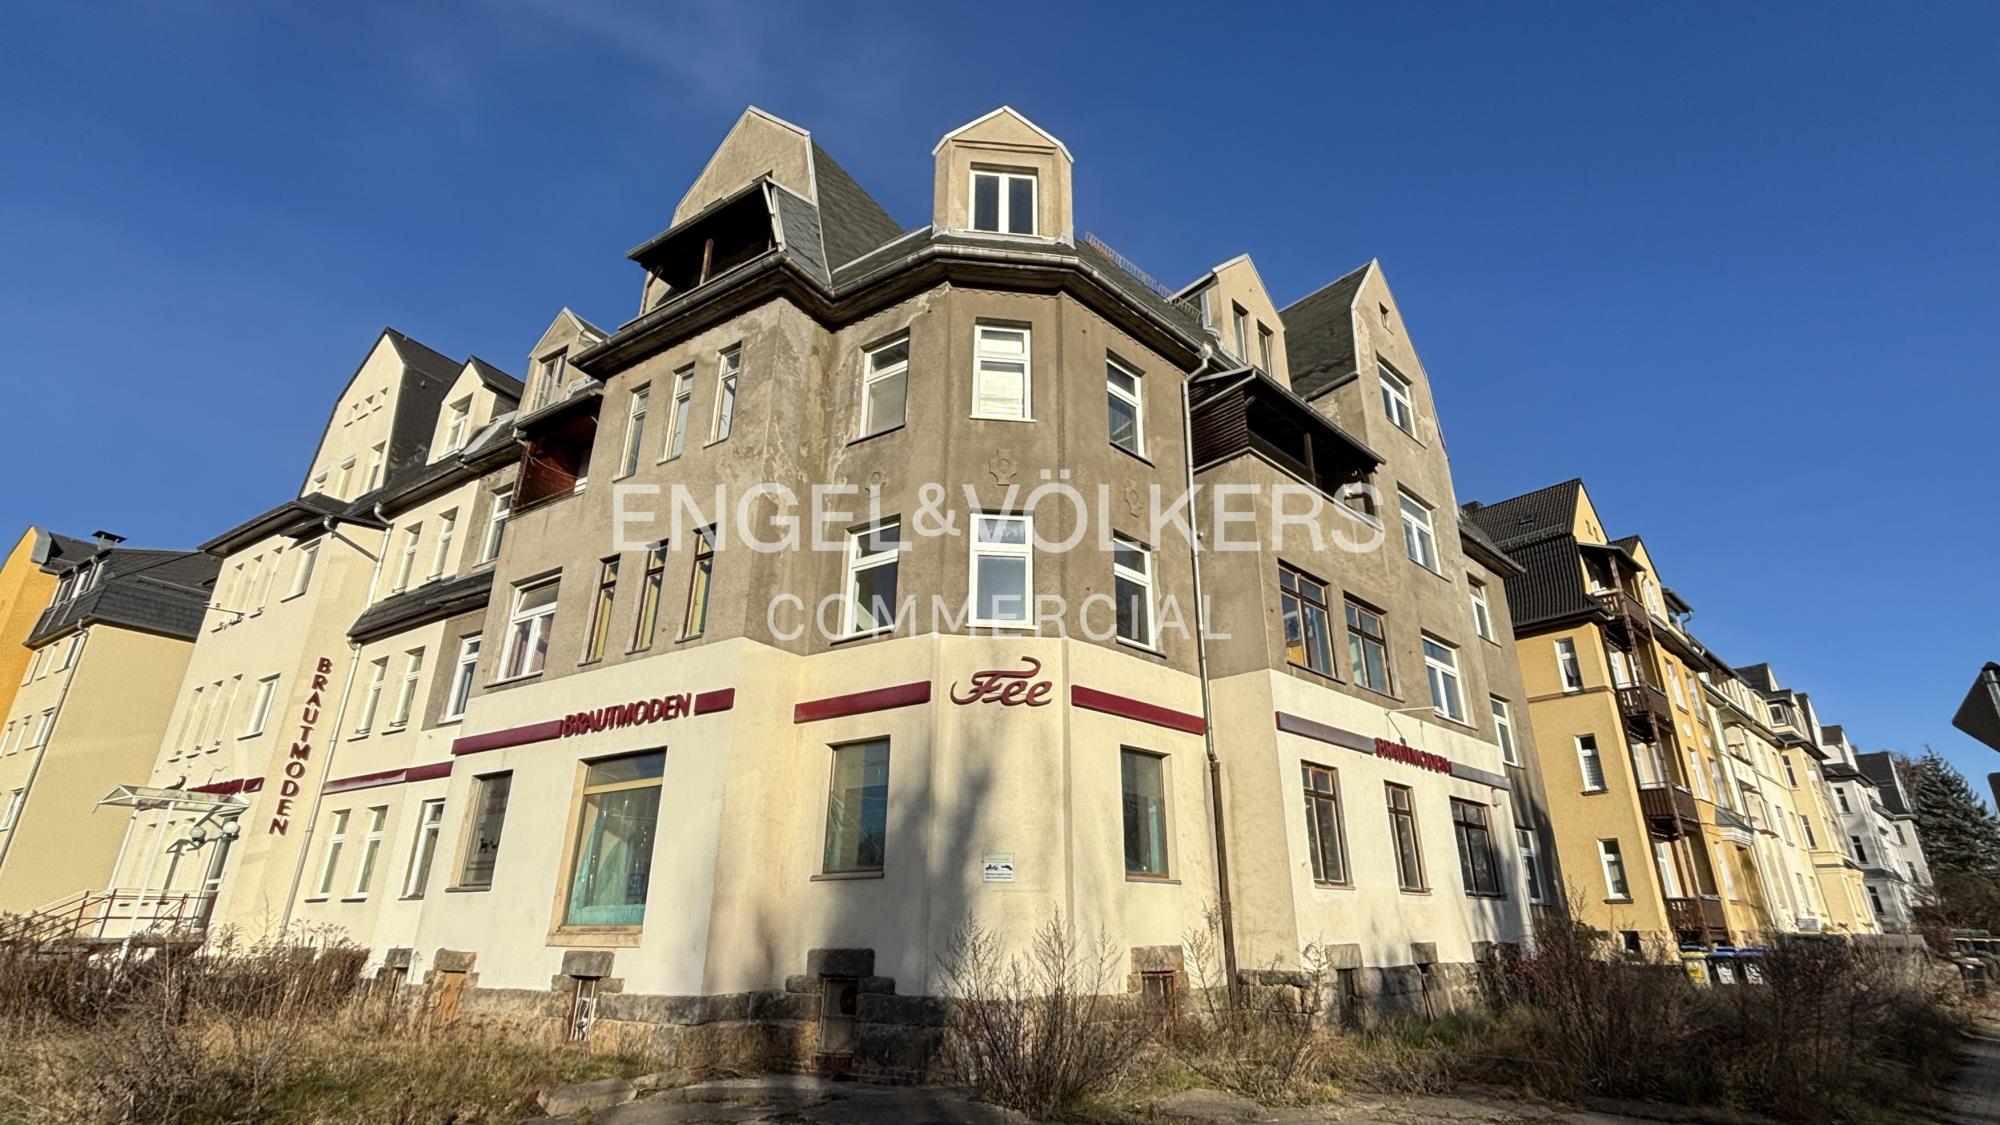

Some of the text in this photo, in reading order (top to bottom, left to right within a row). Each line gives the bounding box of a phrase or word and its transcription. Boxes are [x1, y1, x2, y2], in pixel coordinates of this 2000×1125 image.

[950, 656, 1053, 707] Fee
[563, 692, 692, 738] BRAUTMODEN
[268, 656, 333, 836] BRAUTMODEN
